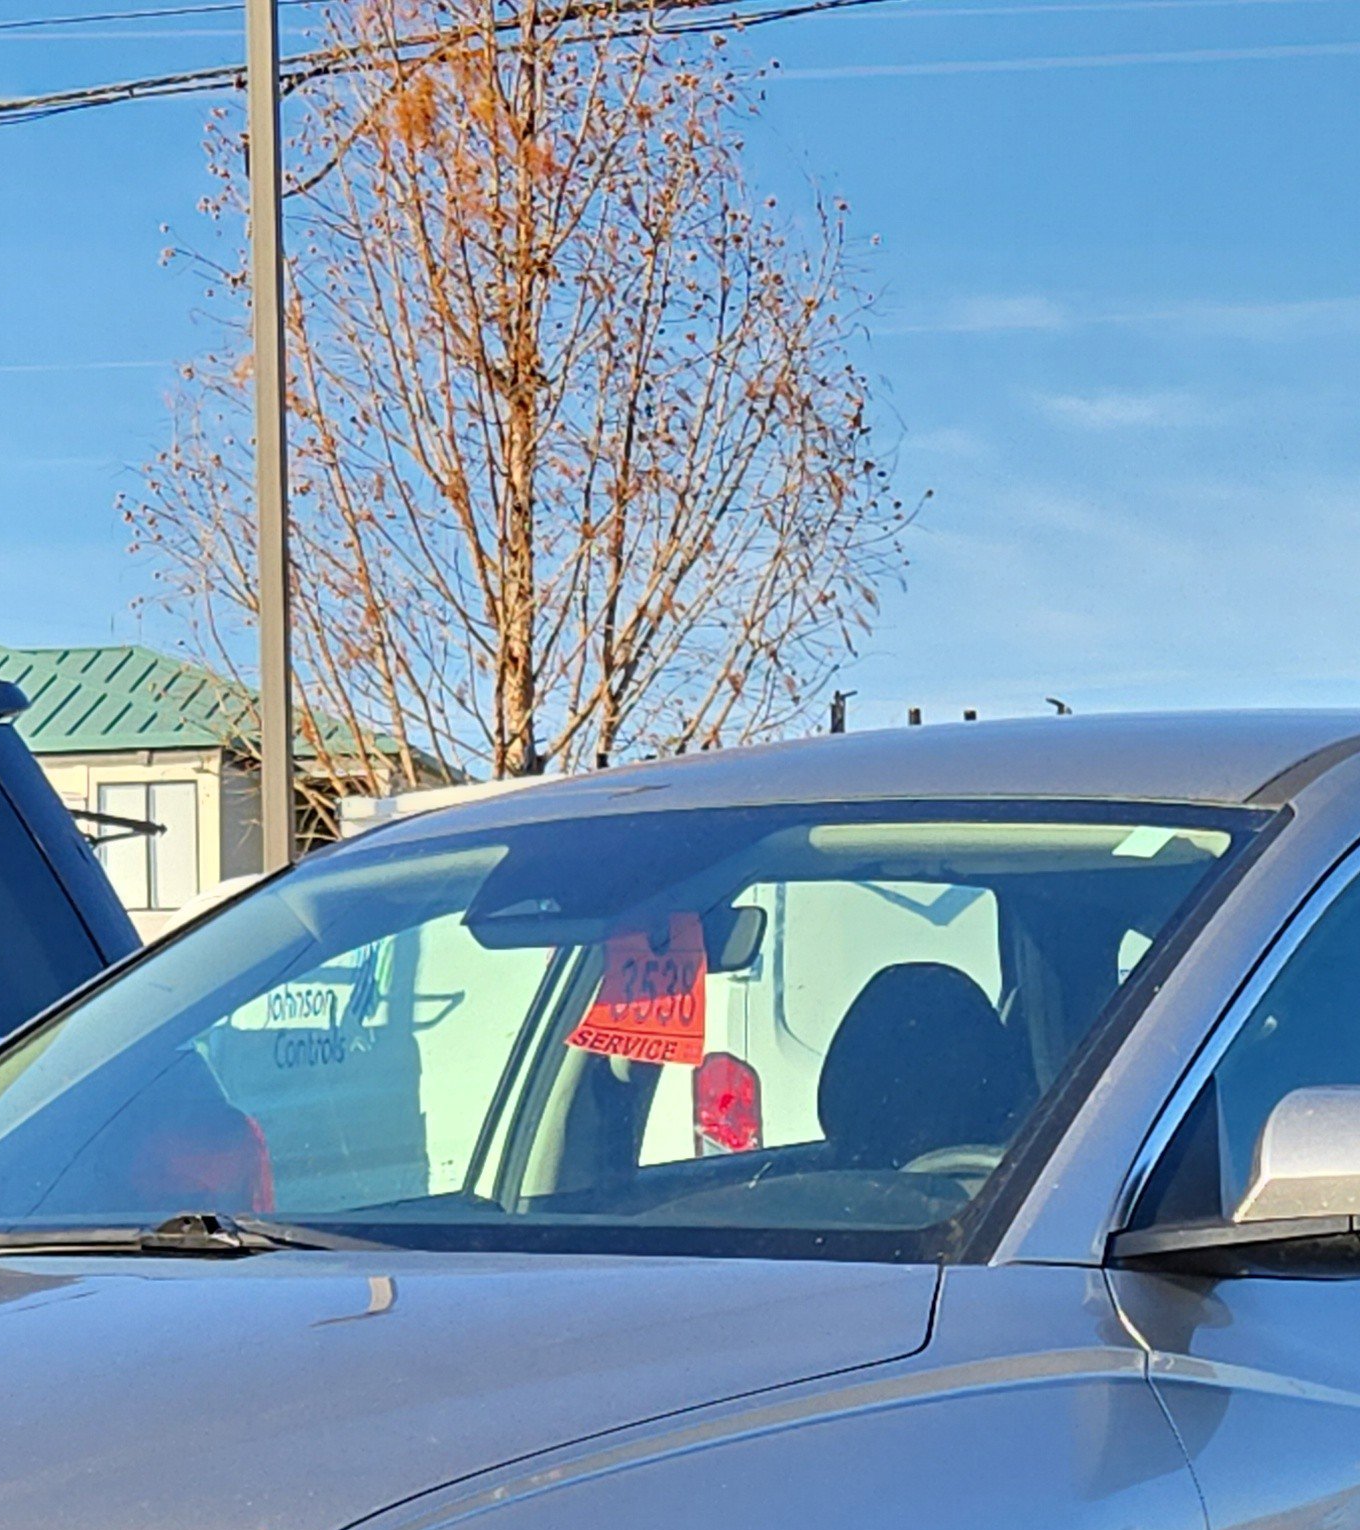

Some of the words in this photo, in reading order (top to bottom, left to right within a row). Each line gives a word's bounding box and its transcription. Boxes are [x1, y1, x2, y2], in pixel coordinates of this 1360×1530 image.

[264, 985, 338, 1026] Johnson
[275, 1030, 346, 1067] Controls
[572, 1030, 678, 1062] SERVICE
